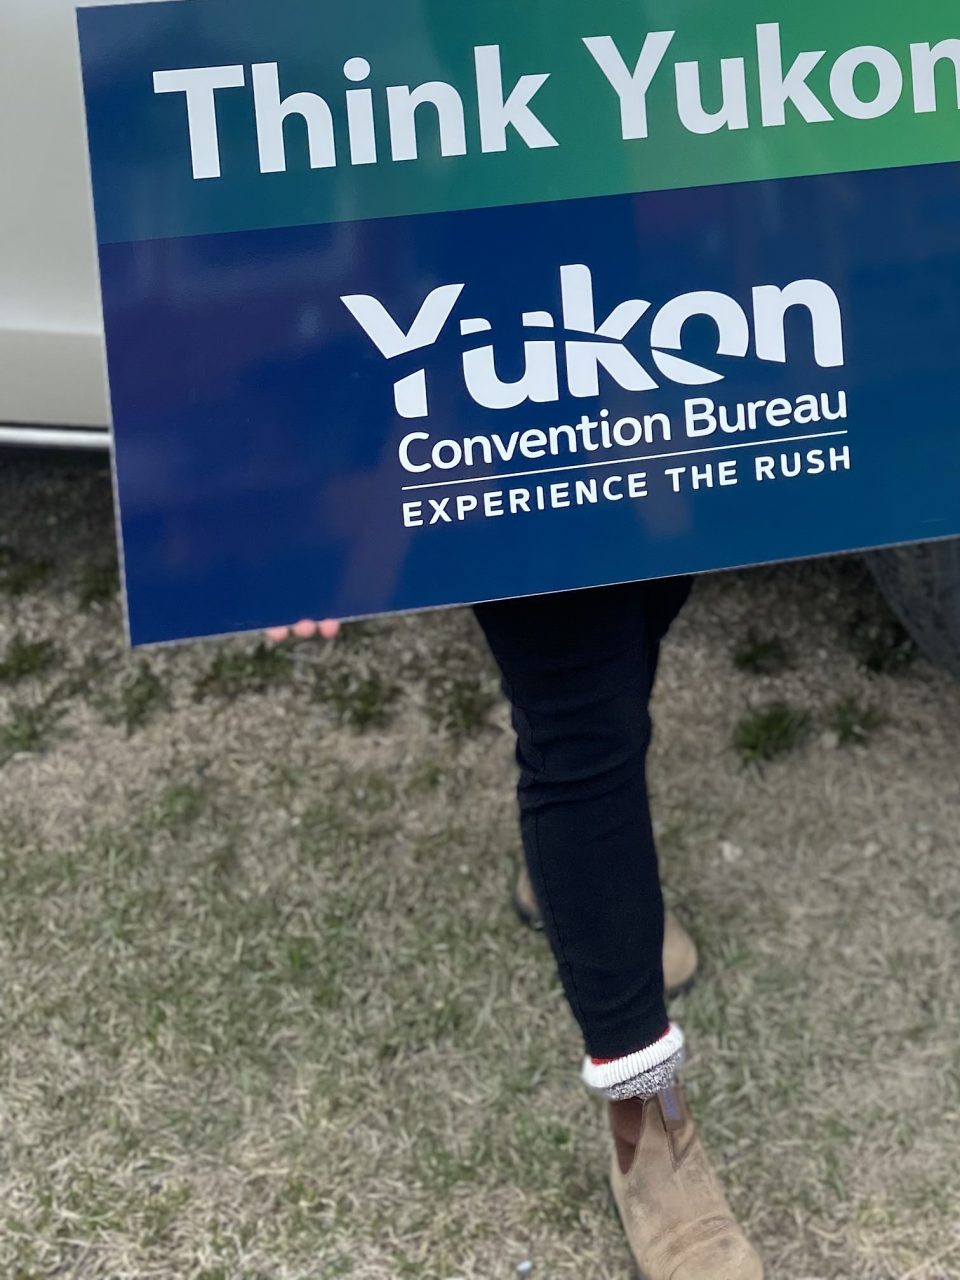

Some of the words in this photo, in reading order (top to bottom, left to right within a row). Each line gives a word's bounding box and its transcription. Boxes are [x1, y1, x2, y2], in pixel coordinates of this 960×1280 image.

[152, 44, 560, 180] Think
[339, 263, 844, 419] Yukon
[398, 408, 673, 473] Convention
[684, 390, 847, 438] Bureau
[402, 472, 648, 528] EXPERIENCE
[664, 457, 738, 493] THE
[754, 445, 850, 481] RUSH
